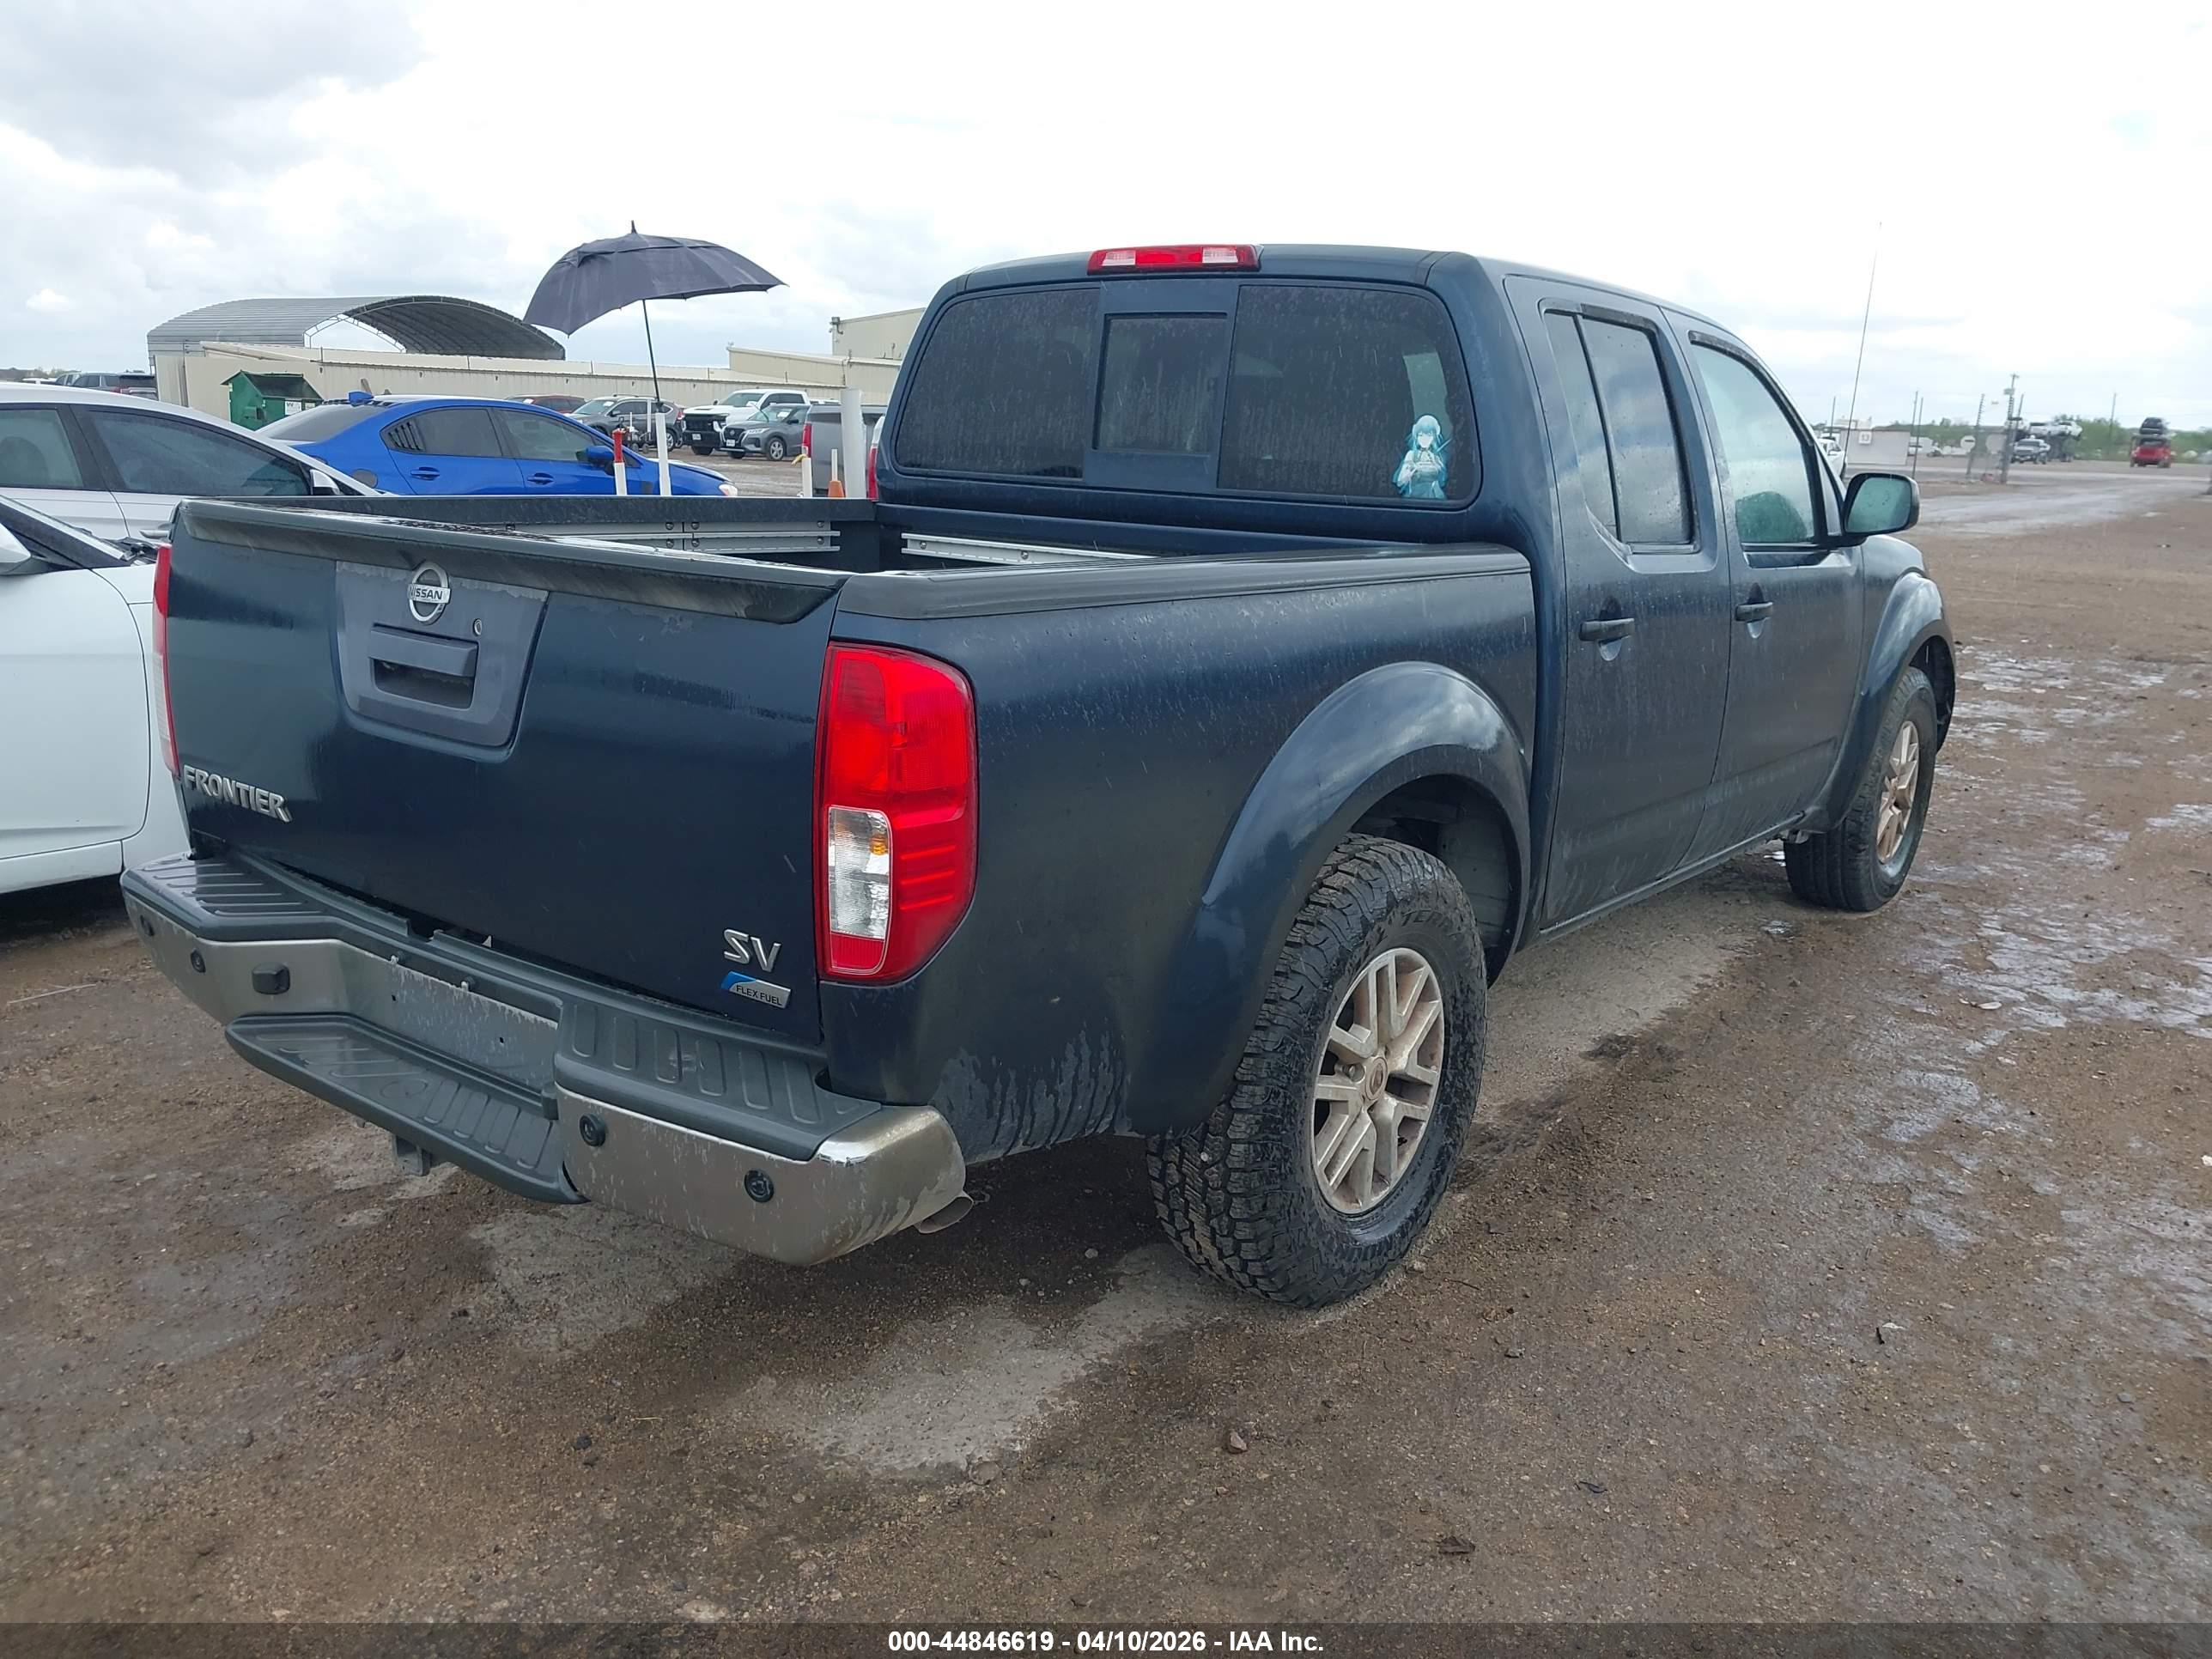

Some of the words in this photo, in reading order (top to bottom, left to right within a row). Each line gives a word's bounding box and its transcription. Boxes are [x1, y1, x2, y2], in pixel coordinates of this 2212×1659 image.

[410, 586, 443, 600] NISSAN
[184, 764, 291, 823] FRONTIER
[724, 929, 781, 972] SV
[736, 985, 758, 998] FLEX
[760, 992, 783, 1006] FUEL
